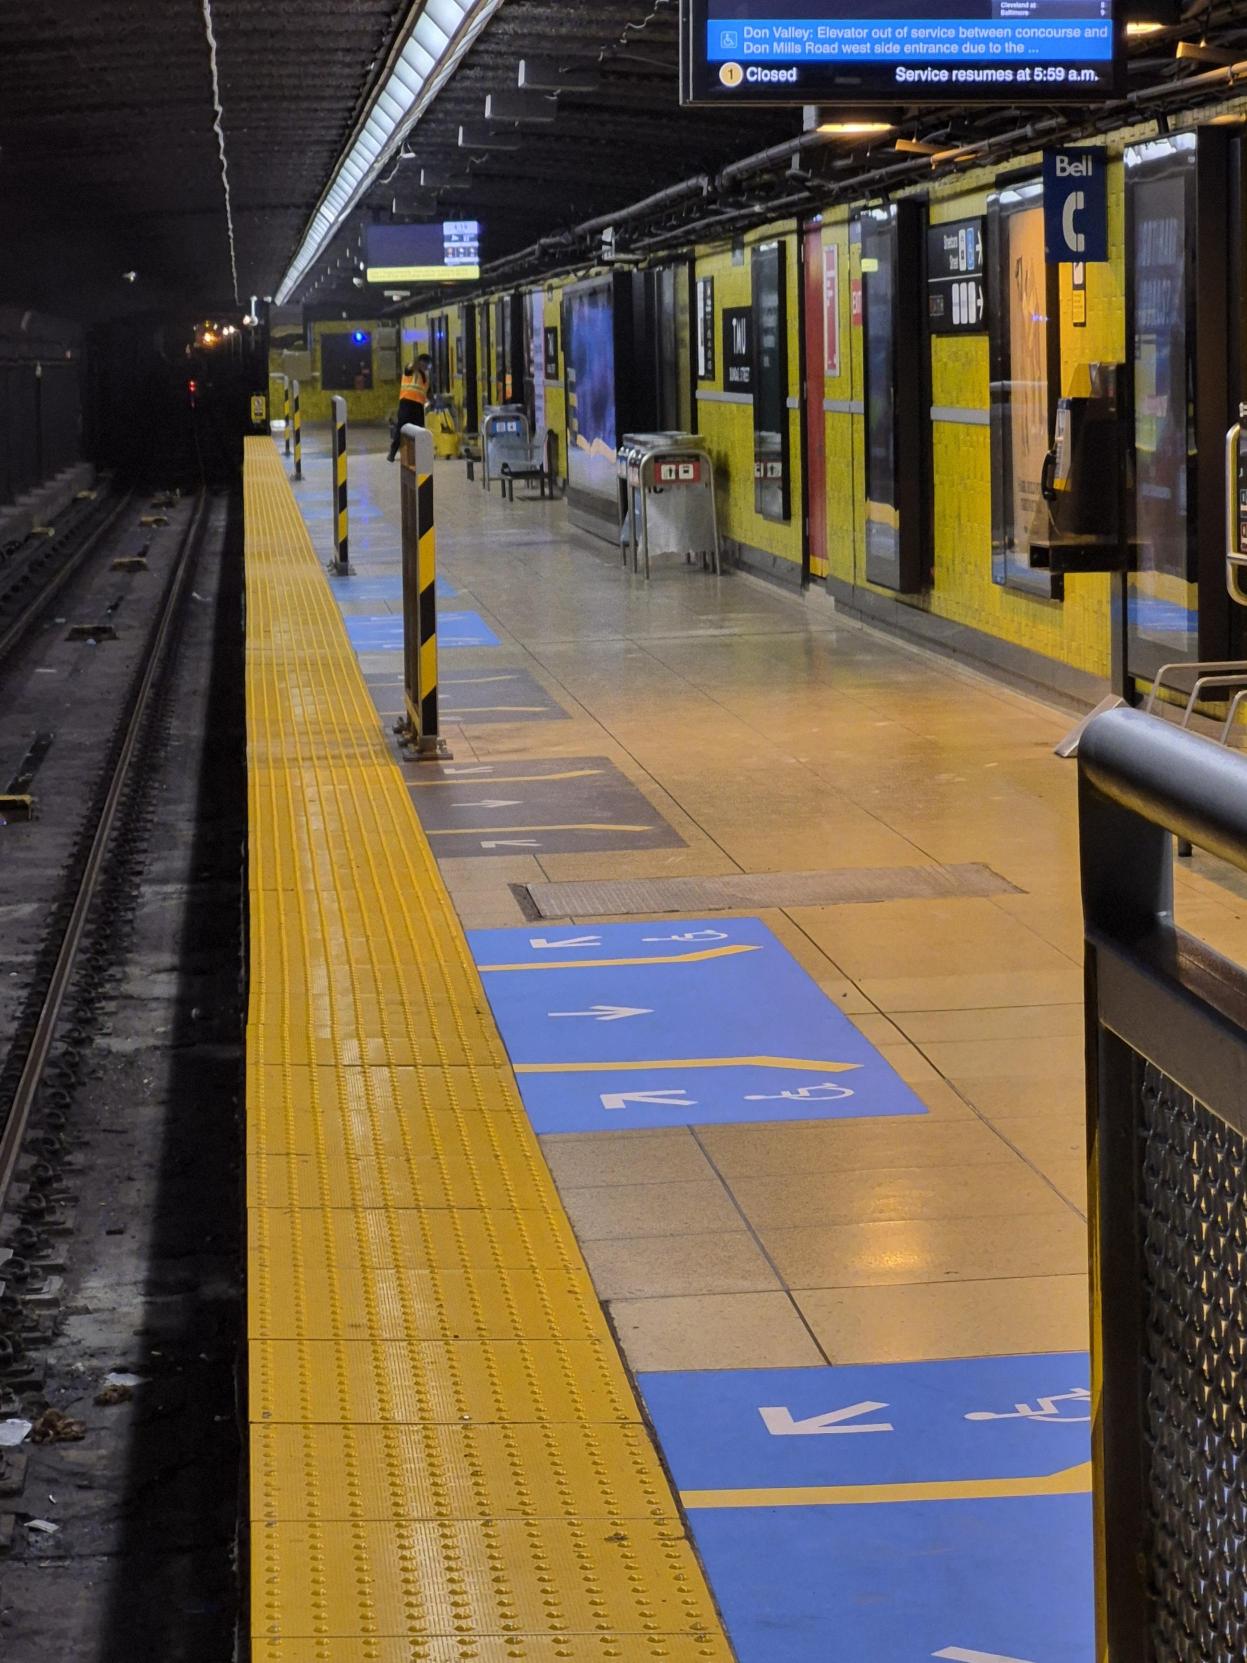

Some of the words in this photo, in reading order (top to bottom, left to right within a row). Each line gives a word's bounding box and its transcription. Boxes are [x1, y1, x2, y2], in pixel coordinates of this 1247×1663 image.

[743, 26, 769, 38] Don
[773, 26, 813, 41] Valley:
[817, 26, 868, 38] Elevator
[871, 27, 892, 38] out
[895, 26, 907, 38] of
[911, 26, 955, 38] service
[959, 26, 1011, 38] between
[1015, 27, 1081, 38] concourse
[1084, 26, 1108, 38] and
[743, 42, 769, 54] Don
[773, 42, 801, 54] Mills
[805, 42, 838, 54] Road
[841, 43, 870, 54] west
[874, 42, 899, 54] side
[904, 42, 958, 54] entrance
[962, 42, 985, 54] due
[989, 43, 1001, 54] to
[1005, 42, 1025, 54] the
[727, 68, 734, 80] 1
[746, 67, 797, 82] Closed
[896, 67, 948, 82] Service
[952, 69, 1013, 82] resumes
[1016, 68, 1030, 82] at
[1034, 67, 1065, 82] 5:59
[1068, 69, 1099, 82] a.m.
[1056, 155, 1093, 177] Bell
[731, 317, 746, 354] TMU
